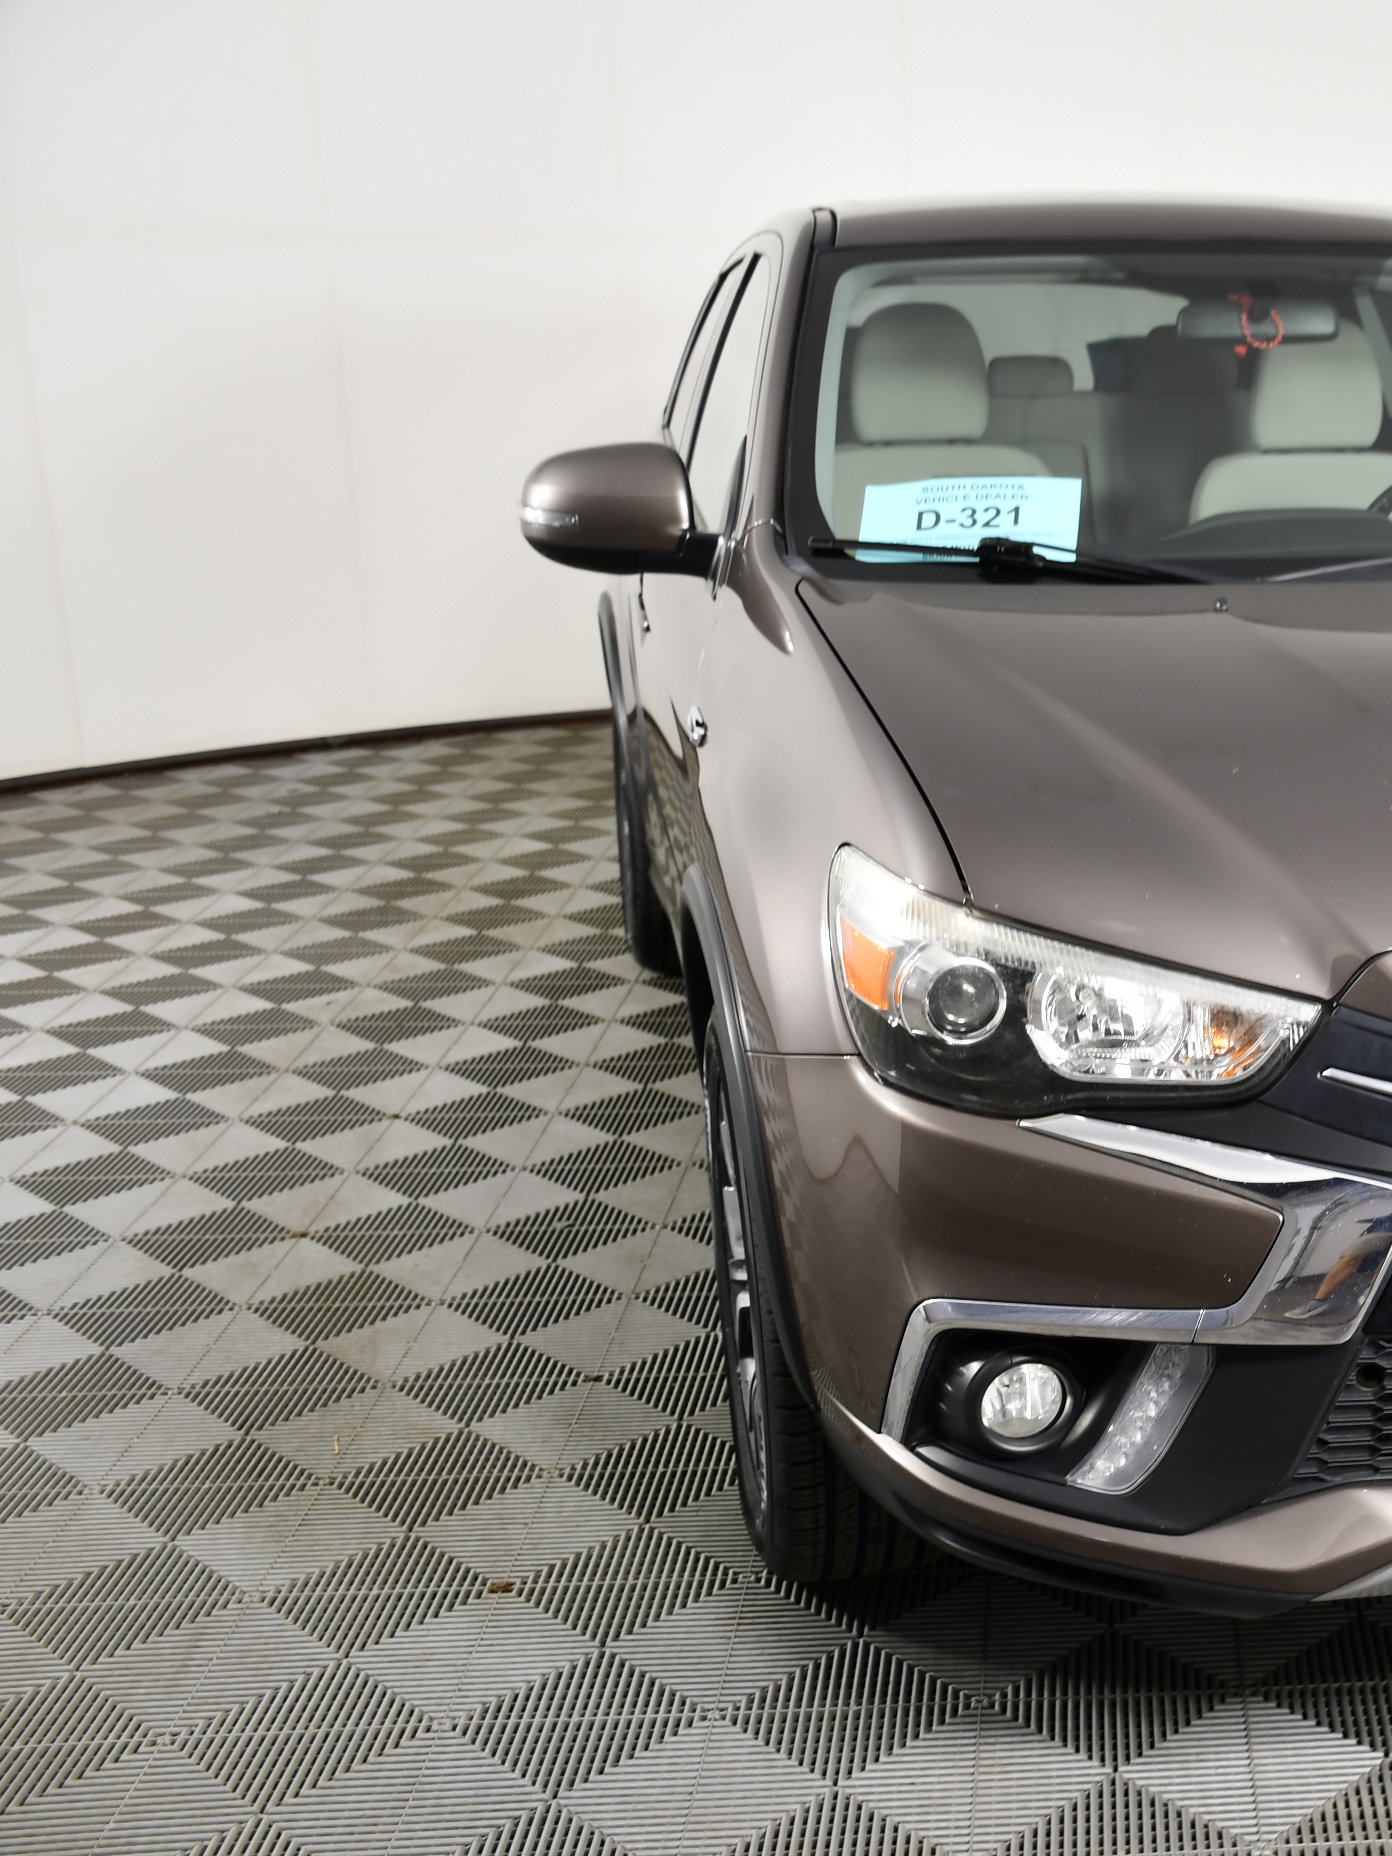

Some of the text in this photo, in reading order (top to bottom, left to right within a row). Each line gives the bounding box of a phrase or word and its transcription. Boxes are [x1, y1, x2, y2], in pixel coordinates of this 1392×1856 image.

[922, 483, 1025, 493] SOUTH DAKOTA
[916, 492, 1029, 505] VEHICLE DEALER
[916, 505, 1020, 531] D-321
